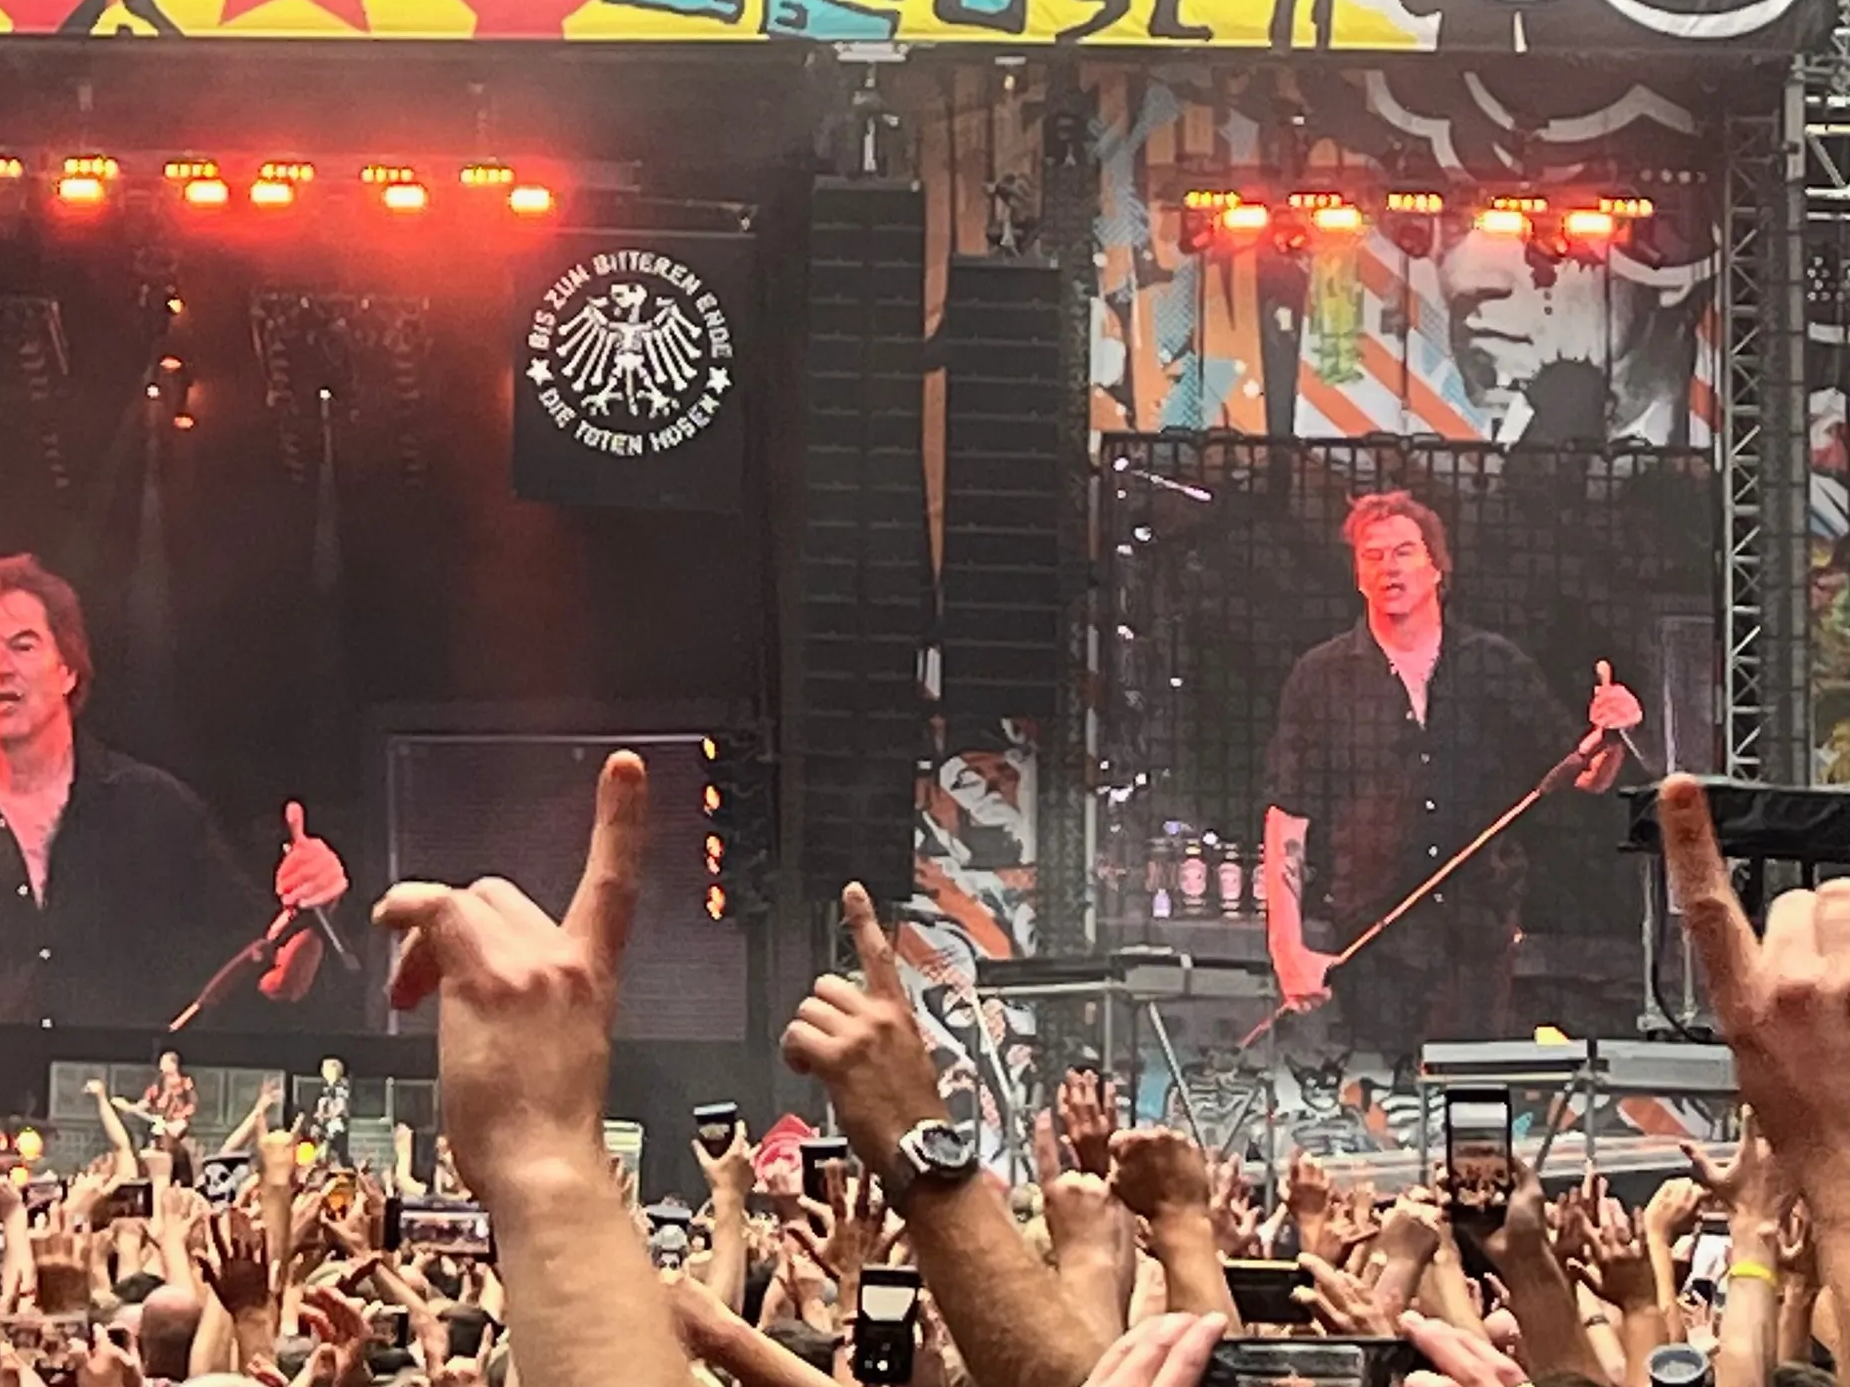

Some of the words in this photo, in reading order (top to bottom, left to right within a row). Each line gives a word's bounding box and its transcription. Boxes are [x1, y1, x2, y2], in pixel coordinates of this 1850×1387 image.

[527, 309, 556, 351] BIS
[544, 264, 591, 311] ZUM
[695, 292, 734, 359] ENDE
[538, 387, 577, 429] DIE
[573, 419, 643, 456] TOTEN
[649, 393, 720, 452] HOSEN
